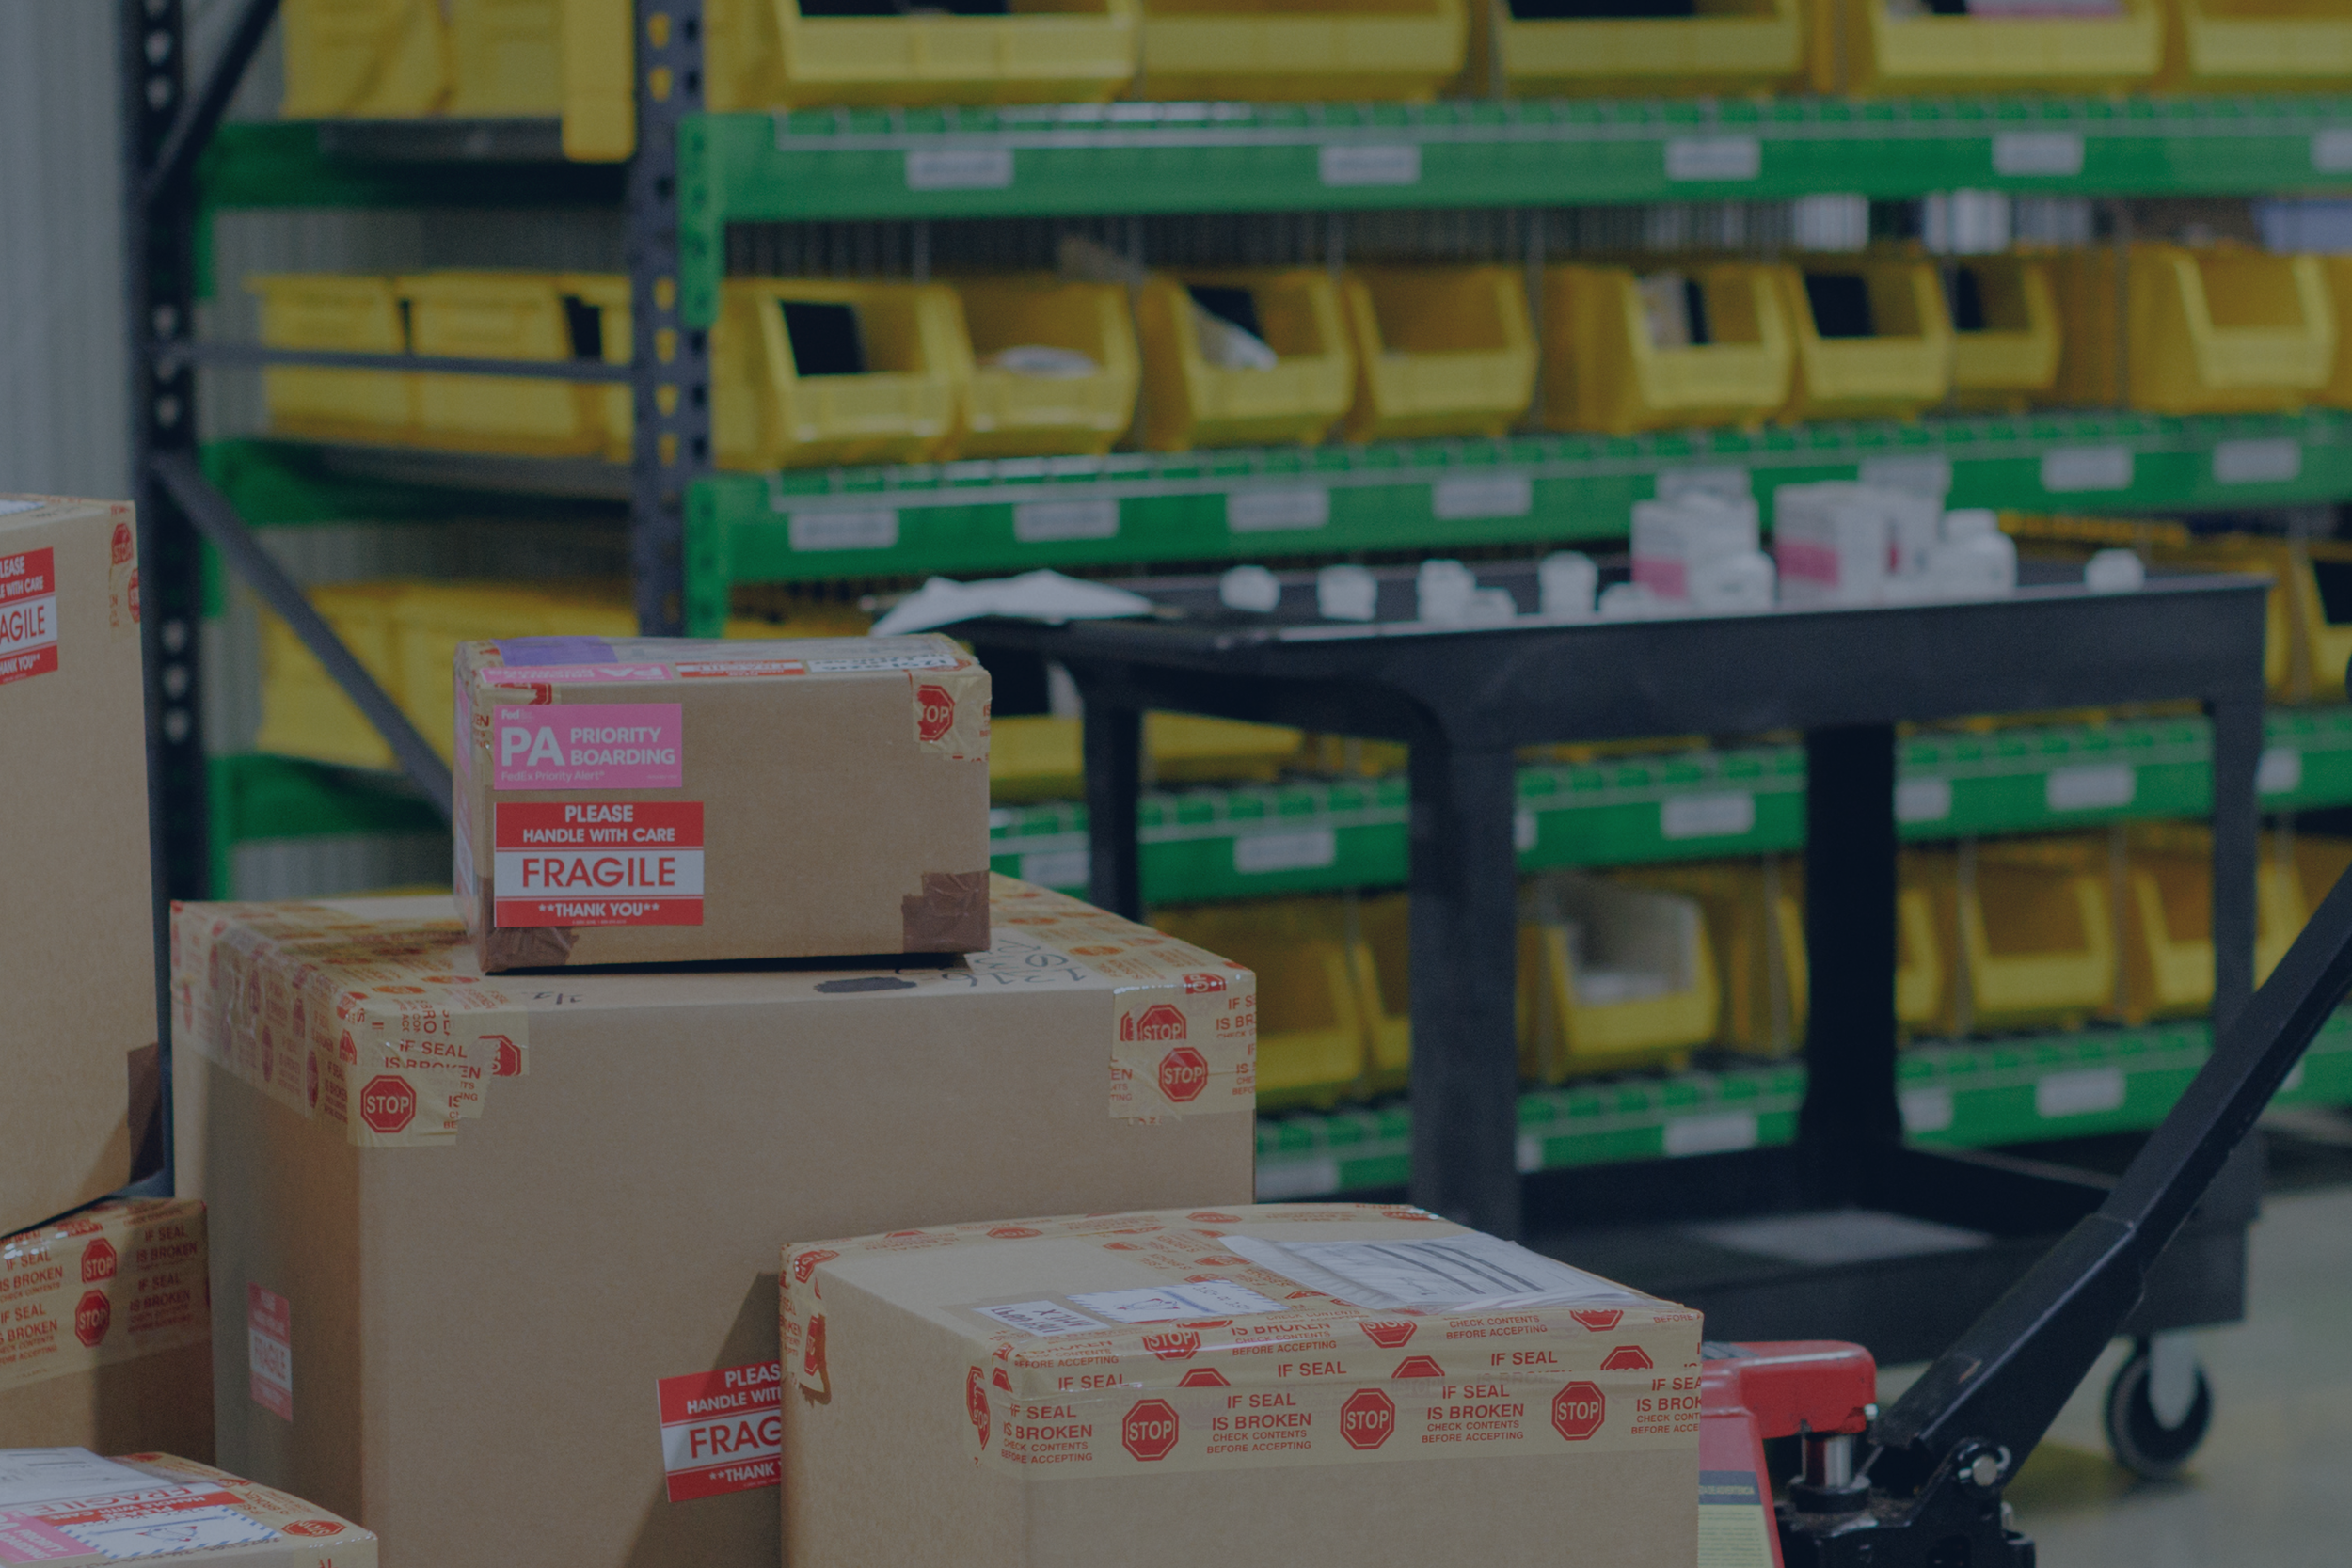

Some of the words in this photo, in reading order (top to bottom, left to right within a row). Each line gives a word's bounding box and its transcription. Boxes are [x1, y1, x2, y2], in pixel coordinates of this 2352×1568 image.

[6, 579, 24, 596] WITH
[24, 575, 44, 594] CARE
[570, 727, 661, 743] PRIORITY
[501, 726, 565, 767] PA
[570, 748, 675, 766] BOARDING
[501, 771, 532, 781] FedEx
[535, 771, 572, 783] Priority
[565, 805, 633, 822] PLEASE
[523, 829, 584, 843] HANDLE
[589, 828, 628, 842] WITH
[632, 828, 675, 842] CARE
[522, 857, 675, 887] FRAGILE
[1229, 997, 1240, 1010] IF
[1143, 1023, 1182, 1041] STOP
[1216, 1018, 1230, 1031] IS
[421, 1041, 469, 1059] SEAL
[1164, 1067, 1203, 1085] STOP
[366, 1095, 410, 1115] STOP
[158, 1224, 186, 1242] SEAL
[151, 1241, 198, 1261] BROKEN
[21, 1251, 52, 1268] SEAL
[84, 1257, 115, 1278] STOP
[13, 1266, 63, 1289] BROKEN
[151, 1272, 181, 1291] SEAL
[143, 1290, 191, 1309] BROKEN
[0, 1311, 11, 1324] IF
[14, 1303, 46, 1322] SEAL
[78, 1308, 106, 1330] STOP
[1449, 1319, 1484, 1328] CHECK
[1487, 1315, 1540, 1326] CONTENTS
[1653, 1314, 1693, 1323] BEFORE
[7, 1319, 57, 1343] BROKEN
[1235, 1336, 1271, 1345] CHECK
[1276, 1331, 1330, 1341] CONTENTS
[1446, 1329, 1486, 1339] BEFORE
[1489, 1324, 1548, 1337] ACCEPTING
[1148, 1331, 1192, 1348] STOP
[1055, 1348, 1112, 1358] CONTENTS
[1232, 1346, 1274, 1356] BEFORE
[1277, 1340, 1337, 1354] ACCEPTING
[1057, 1355, 1120, 1368] ACCEPTING
[1490, 1353, 1506, 1366] IF
[1512, 1351, 1558, 1365] SEAL
[1278, 1364, 1294, 1377] IF
[1299, 1361, 1347, 1377] SEAL
[1058, 1376, 1074, 1390] IF
[1080, 1374, 1129, 1389] SEAL
[1652, 1379, 1666, 1391] IF
[1442, 1386, 1457, 1399] IF
[1463, 1384, 1510, 1398] SEAL
[687, 1391, 747, 1415] HANDLE
[1227, 1396, 1243, 1409] IF
[1248, 1393, 1296, 1408] SEAL
[1636, 1398, 1652, 1412] IS
[1010, 1403, 1021, 1417] IF
[1026, 1404, 1077, 1419] SEAL
[1427, 1406, 1443, 1420] IS
[1449, 1403, 1524, 1419] BROKEN
[1558, 1402, 1599, 1421] STOP
[1636, 1415, 1670, 1423] CHECK
[1212, 1417, 1229, 1431] IS
[1234, 1413, 1311, 1430] BROKEN
[1346, 1410, 1389, 1430] STOP
[1426, 1422, 1462, 1432] CHECK
[1466, 1419, 1519, 1430] CONTENTS
[1003, 1421, 1013, 1437] IS
[1015, 1424, 1093, 1440] BROKEN
[1128, 1419, 1173, 1441] STOP
[1212, 1433, 1249, 1442] CHECK
[1252, 1430, 1307, 1440] CONTENTS
[1422, 1433, 1462, 1443] BEFORE
[1465, 1431, 1523, 1441] ACCEPTING
[1631, 1425, 1670, 1434] BEFORE
[1003, 1438, 1026, 1452] CHECK
[1031, 1441, 1089, 1452] CONTENTS
[1206, 1444, 1249, 1454] BEFORE
[1251, 1441, 1311, 1452] ACCEPTING
[1001, 1449, 1027, 1465] BEFORE
[1030, 1452, 1093, 1464] ACCEPTING
[34, 1486, 193, 1513] FRAGILE
